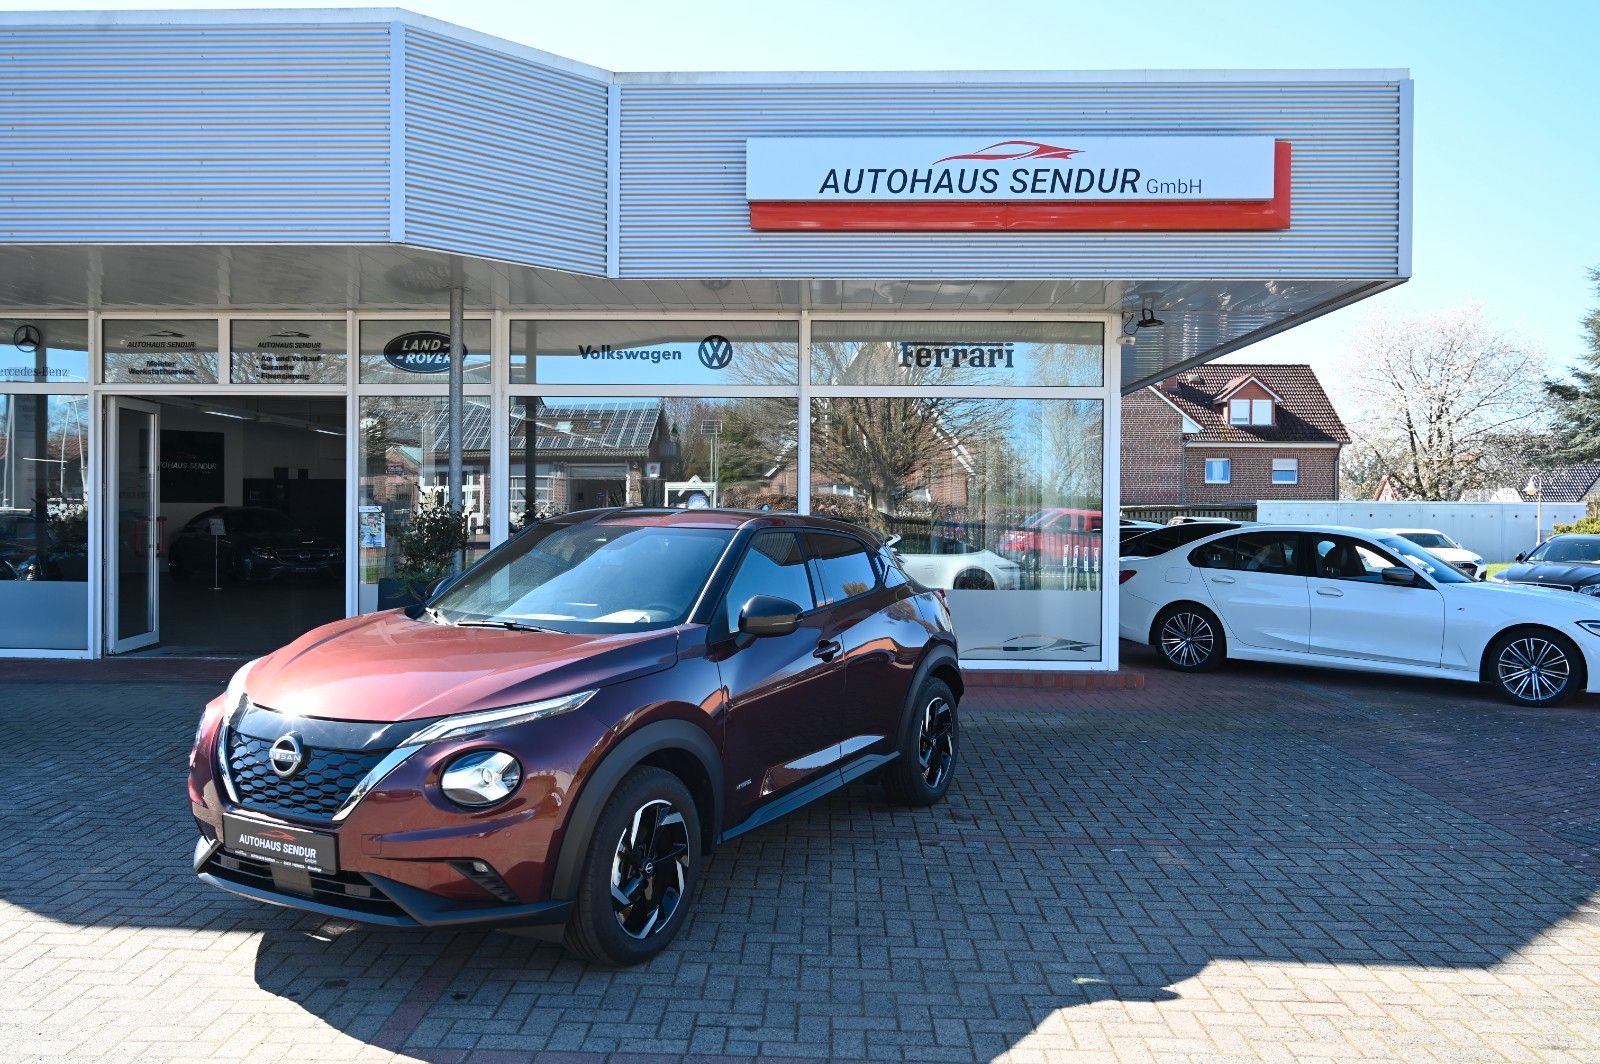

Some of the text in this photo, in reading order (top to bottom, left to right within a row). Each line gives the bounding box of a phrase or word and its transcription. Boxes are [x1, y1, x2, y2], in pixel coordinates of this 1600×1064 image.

[819, 168, 1202, 194] AUTOHAUS SENDUR GmbH
[402, 339, 442, 351] LAND
[578, 345, 682, 364] Volkswagen
[899, 341, 1015, 368] Ferrari
[0, 366, 69, 377] ercedes-Benz
[239, 834, 317, 859] AUTOHAUS SENDUR
